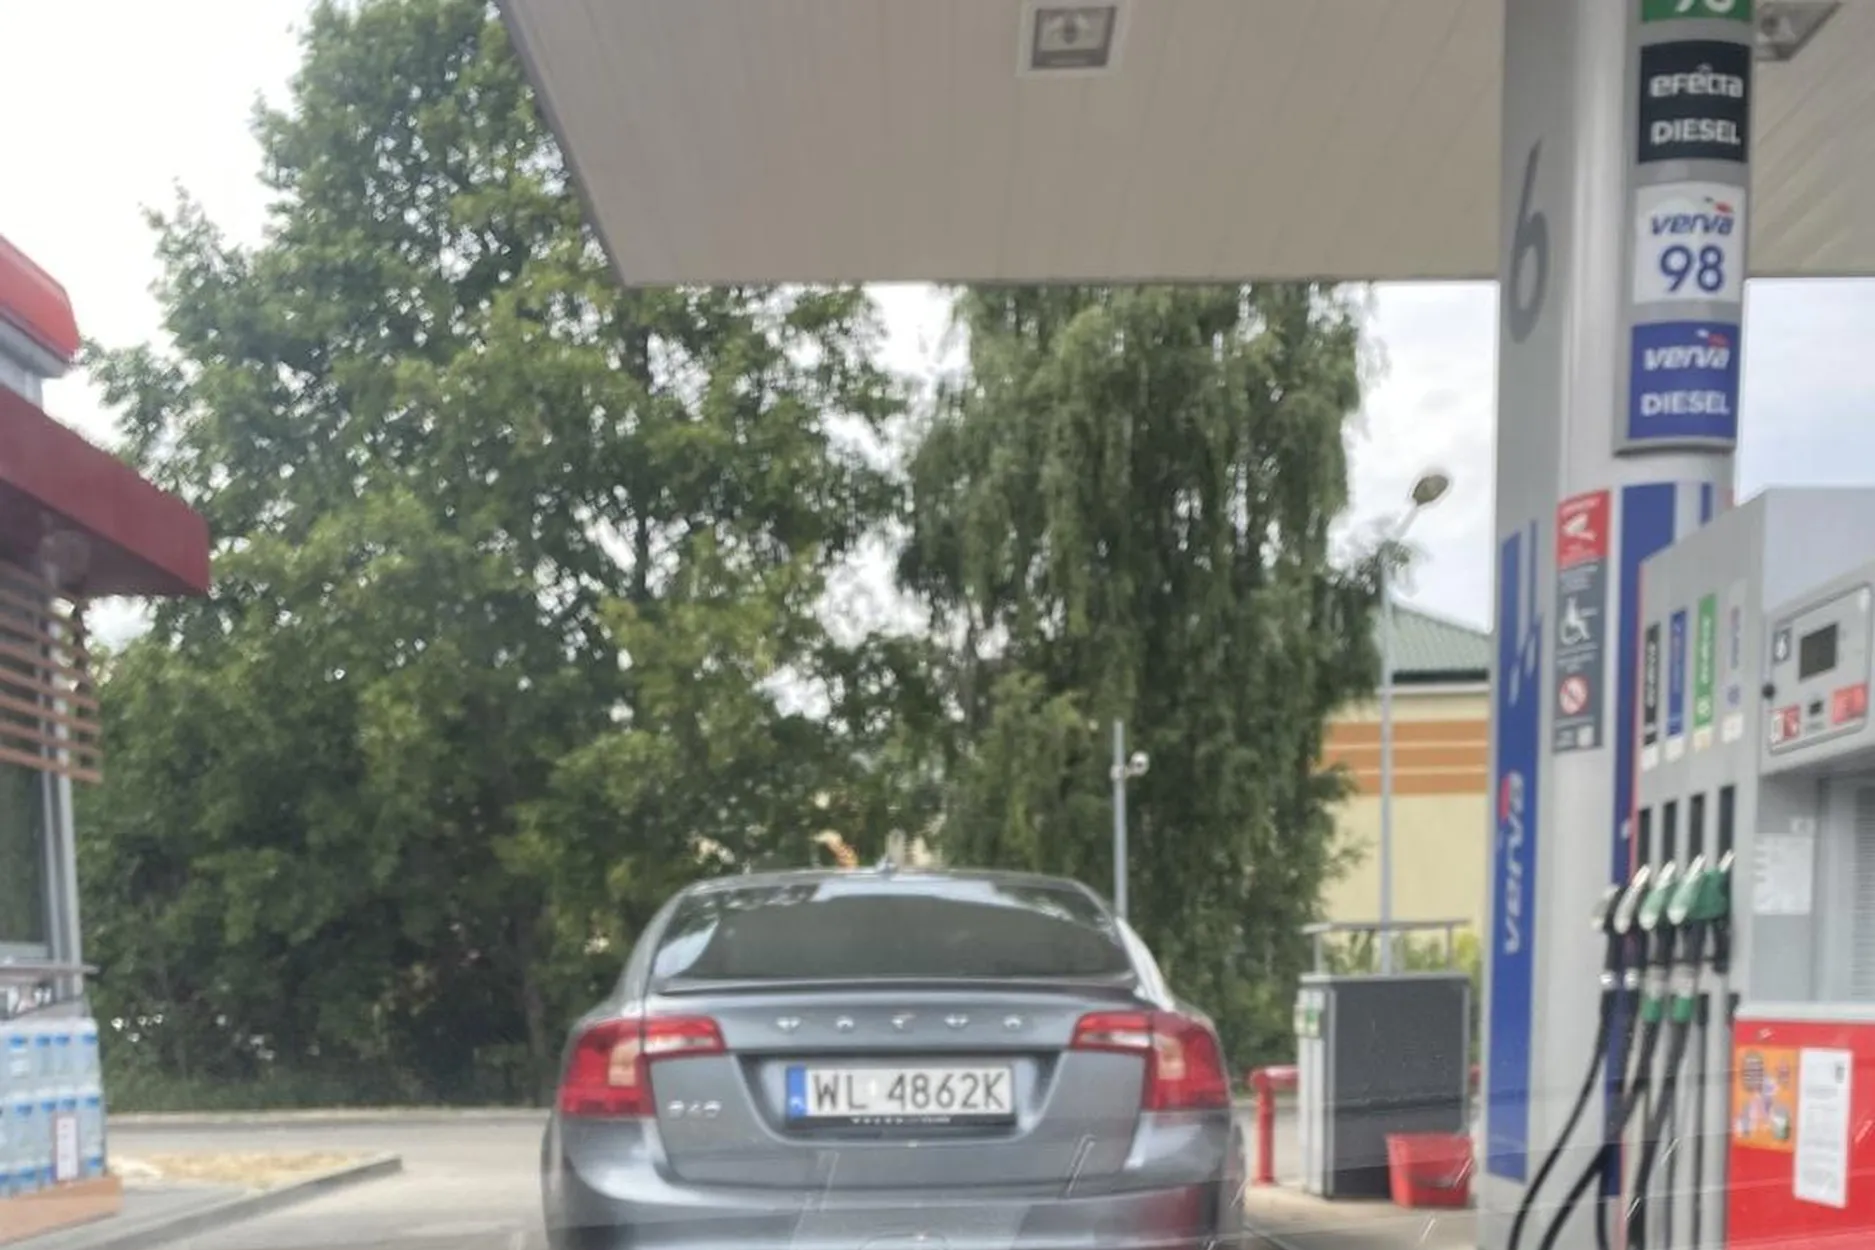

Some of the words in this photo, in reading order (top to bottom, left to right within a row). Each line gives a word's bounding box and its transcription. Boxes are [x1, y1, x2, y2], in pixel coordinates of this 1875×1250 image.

[1651, 118, 1741, 144] DIESEL
[1651, 213, 1733, 235] verva
[1660, 245, 1724, 292] 98
[1643, 346, 1730, 371] verva
[1640, 390, 1730, 416] DIESEL
[813, 1073, 868, 1110] WL
[887, 1073, 1005, 1110] 4862K
